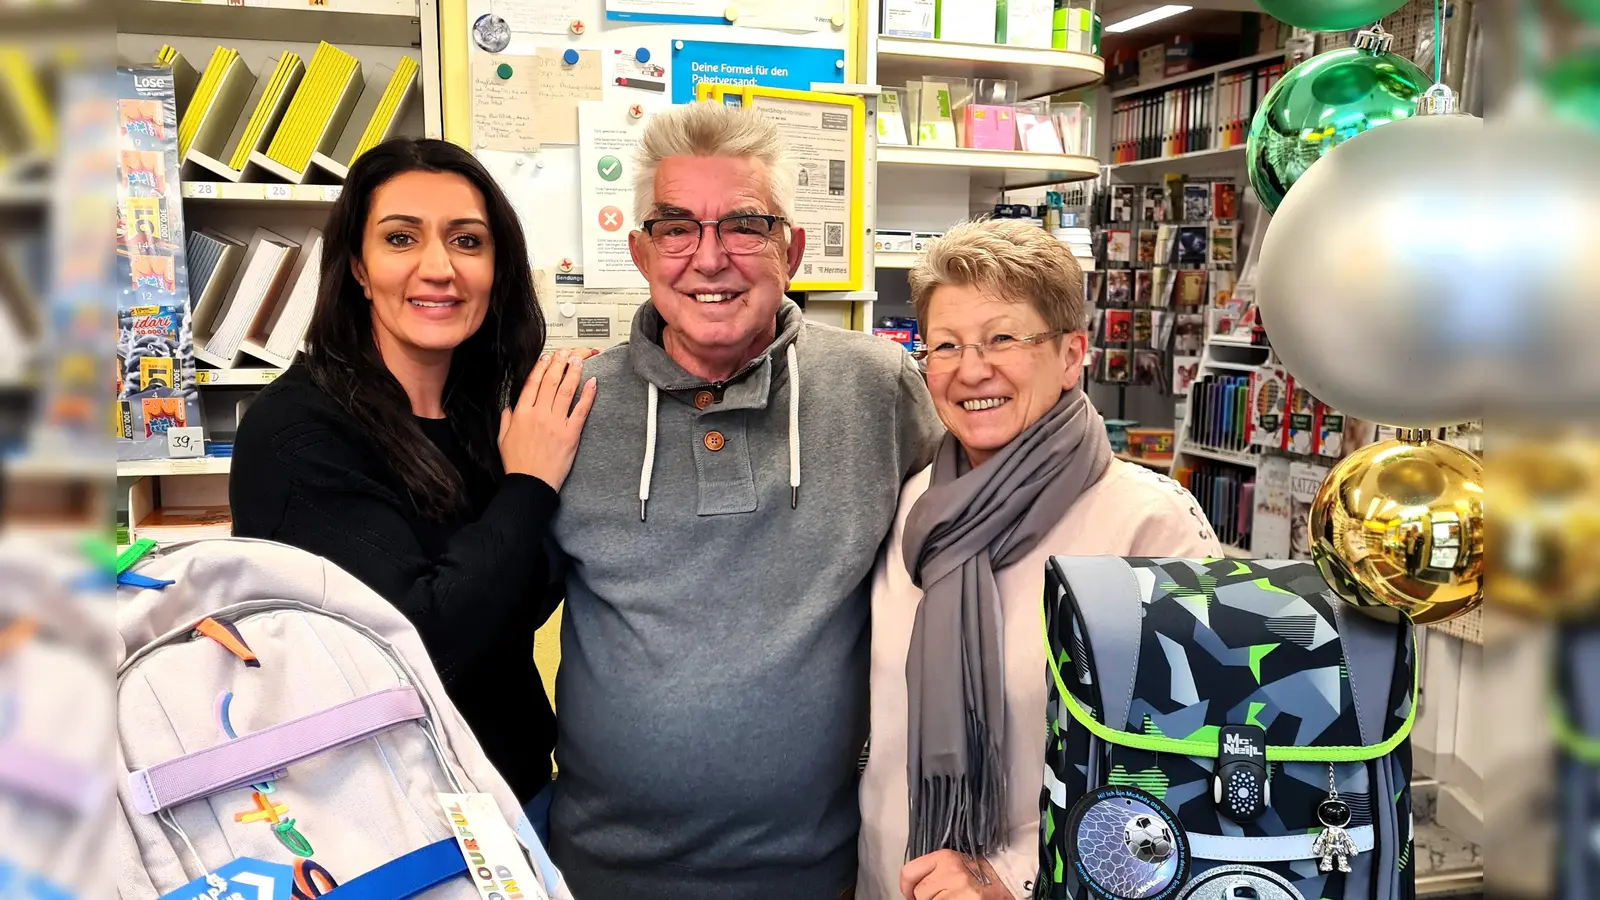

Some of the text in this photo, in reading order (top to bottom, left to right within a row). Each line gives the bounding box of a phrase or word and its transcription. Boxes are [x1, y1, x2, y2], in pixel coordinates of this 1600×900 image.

[692, 61, 788, 76] Deine Formel für den
[134, 74, 165, 88] Lose
[692, 74, 758, 86] Paketversand:
[198, 184, 212, 194] 28
[272, 186, 286, 196] 26
[138, 241, 149, 250] 14
[824, 266, 848, 275] Hermes
[141, 292, 152, 300] 12
[200, 372, 206, 383] 2
[152, 391, 158, 399] 4
[1226, 733, 1249, 748] Mc
[1126, 791, 1150, 803] McAddy
[1160, 810, 1171, 820] und
[1168, 820, 1180, 836] passe
[1177, 836, 1185, 851] auch
[1180, 851, 1185, 859] zu
[1075, 861, 1090, 882] Motive!
[1176, 860, 1185, 880] deinem
[1090, 881, 1105, 895] neuen
